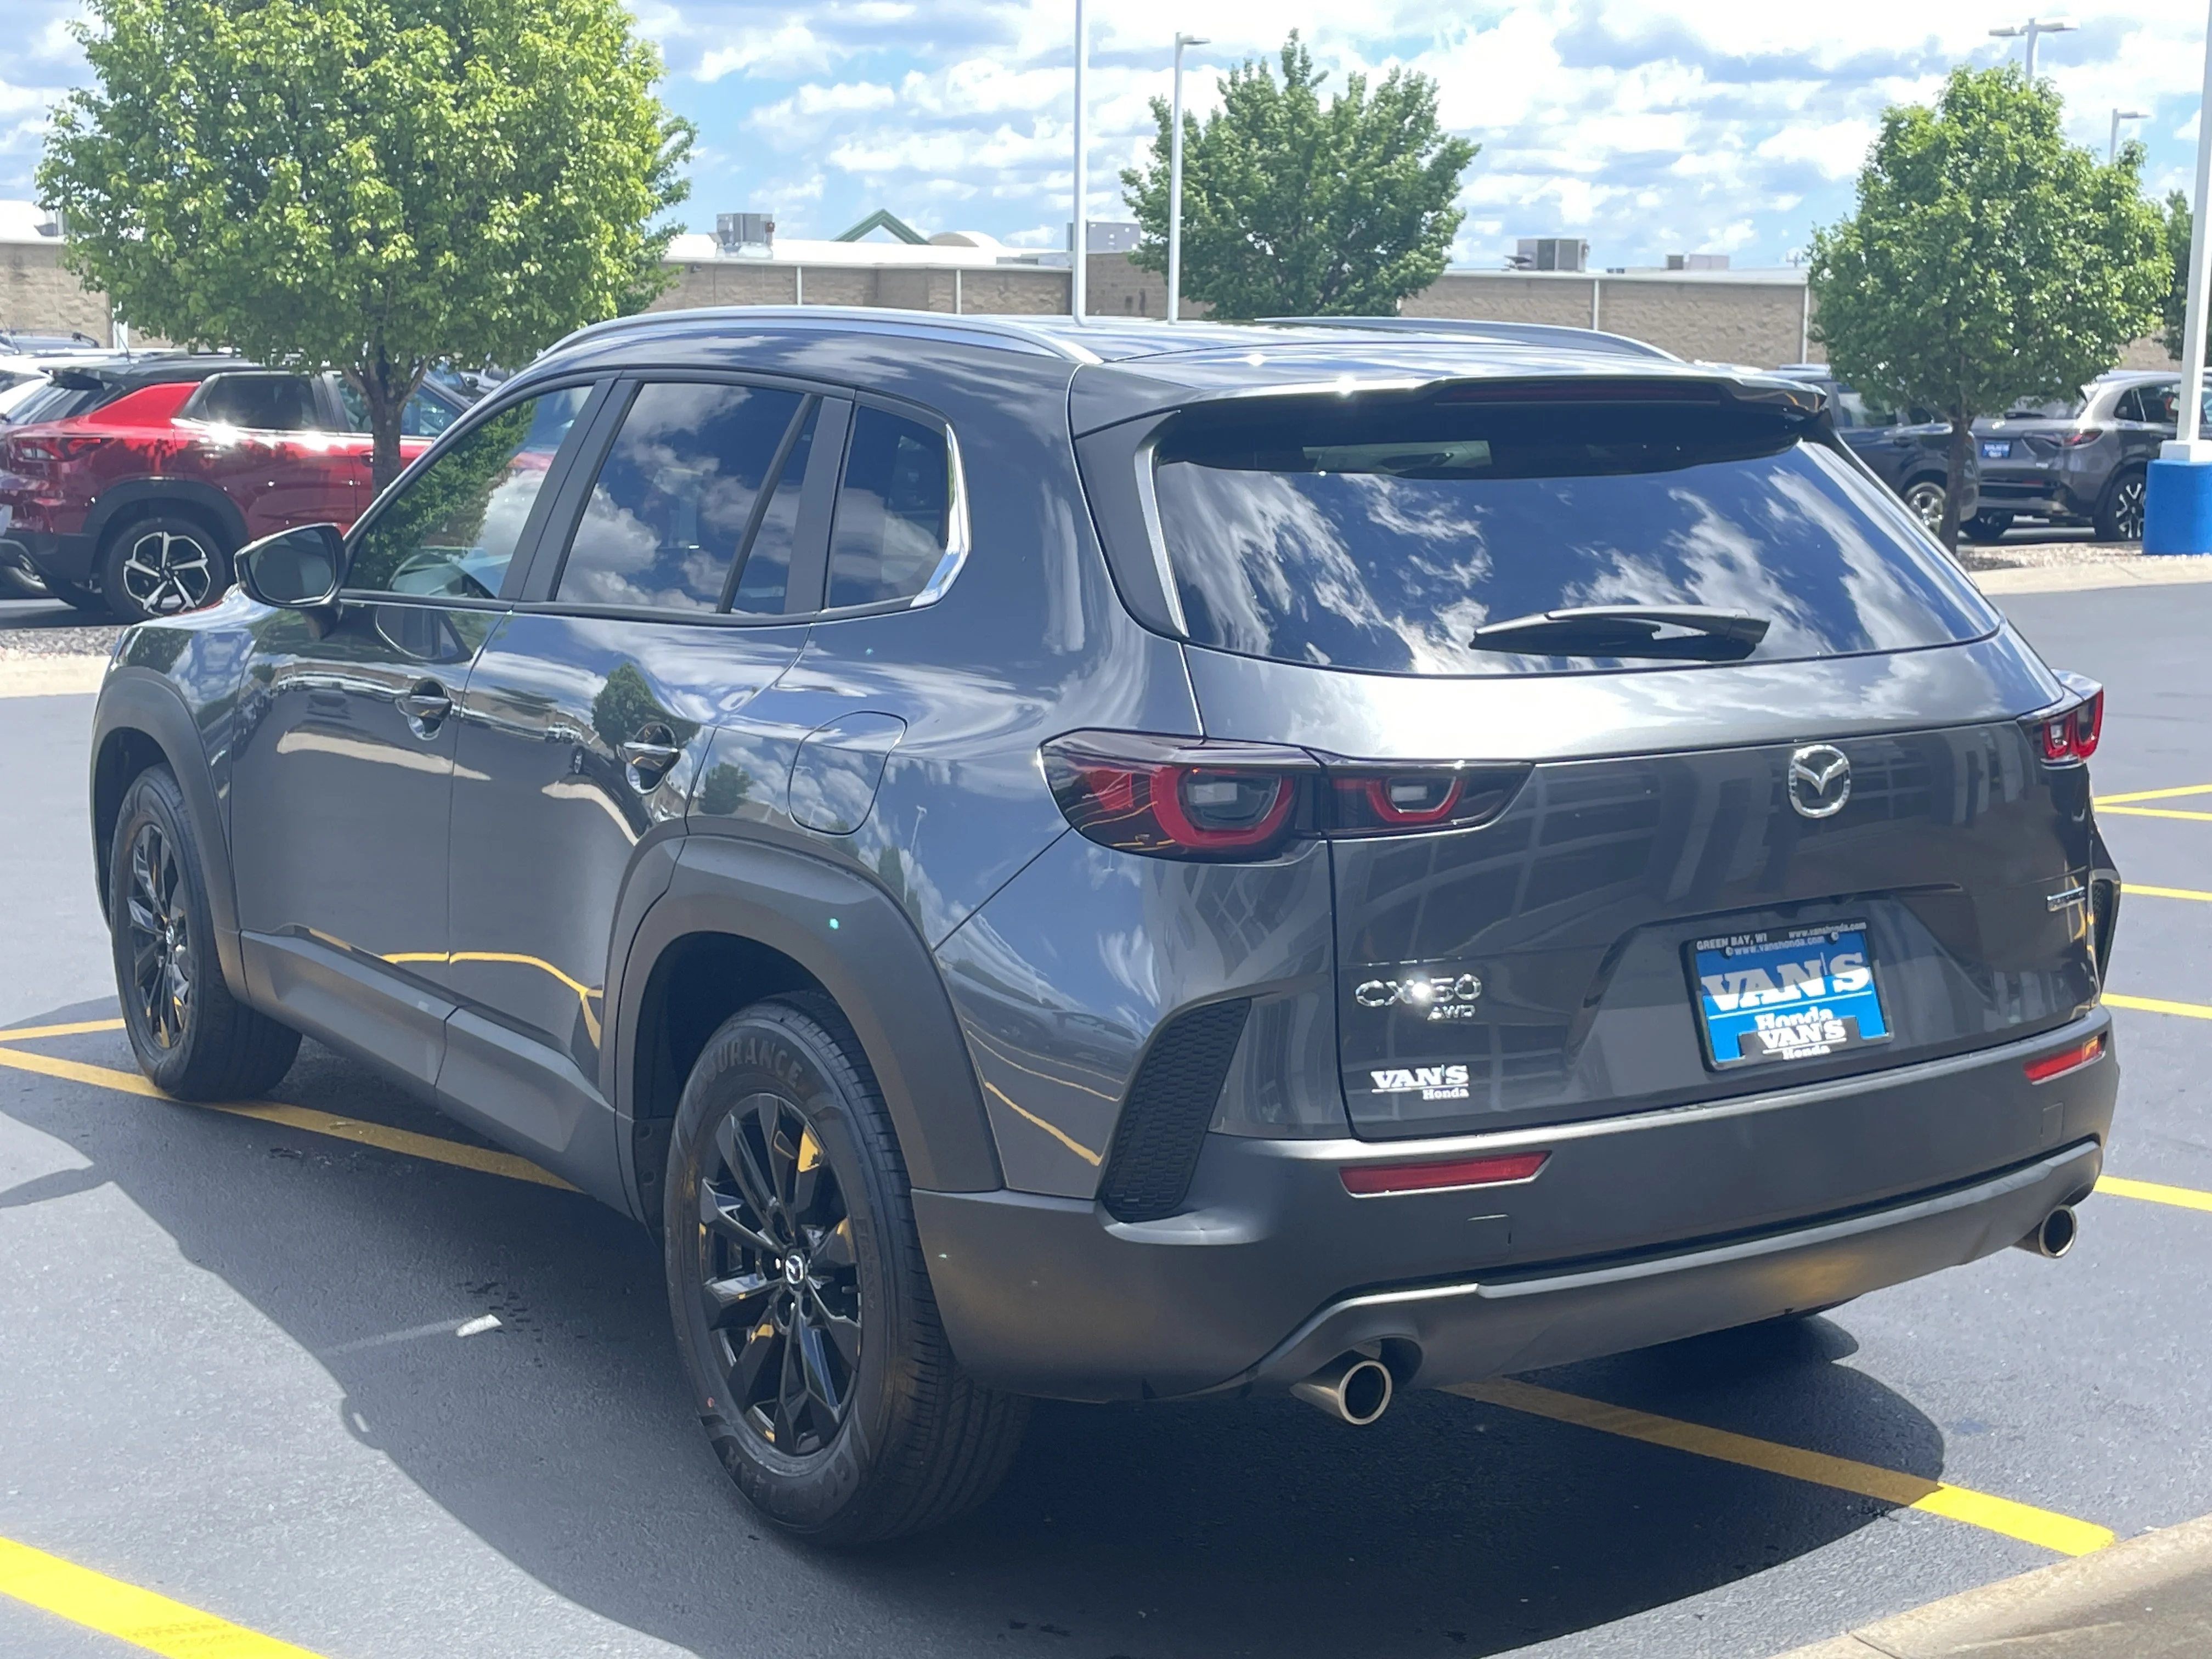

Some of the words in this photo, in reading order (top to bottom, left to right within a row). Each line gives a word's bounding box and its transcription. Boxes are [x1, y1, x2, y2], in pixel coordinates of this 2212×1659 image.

[1696, 936, 1728, 951] GREEN
[1731, 934, 1754, 947] BAY,
[1755, 933, 1768, 943] WI
[1734, 935, 1825, 956] www.vanshonda.com
[1701, 952, 1871, 1011] VAN'S
[1427, 1005, 1476, 1020] AWD
[1755, 1006, 1834, 1030] Honda
[1758, 1019, 1847, 1049] VAN'S
[1782, 1044, 1831, 1060] Honda
[1370, 1064, 1469, 1088] VAN'S
[1422, 1087, 1469, 1100] Honda
